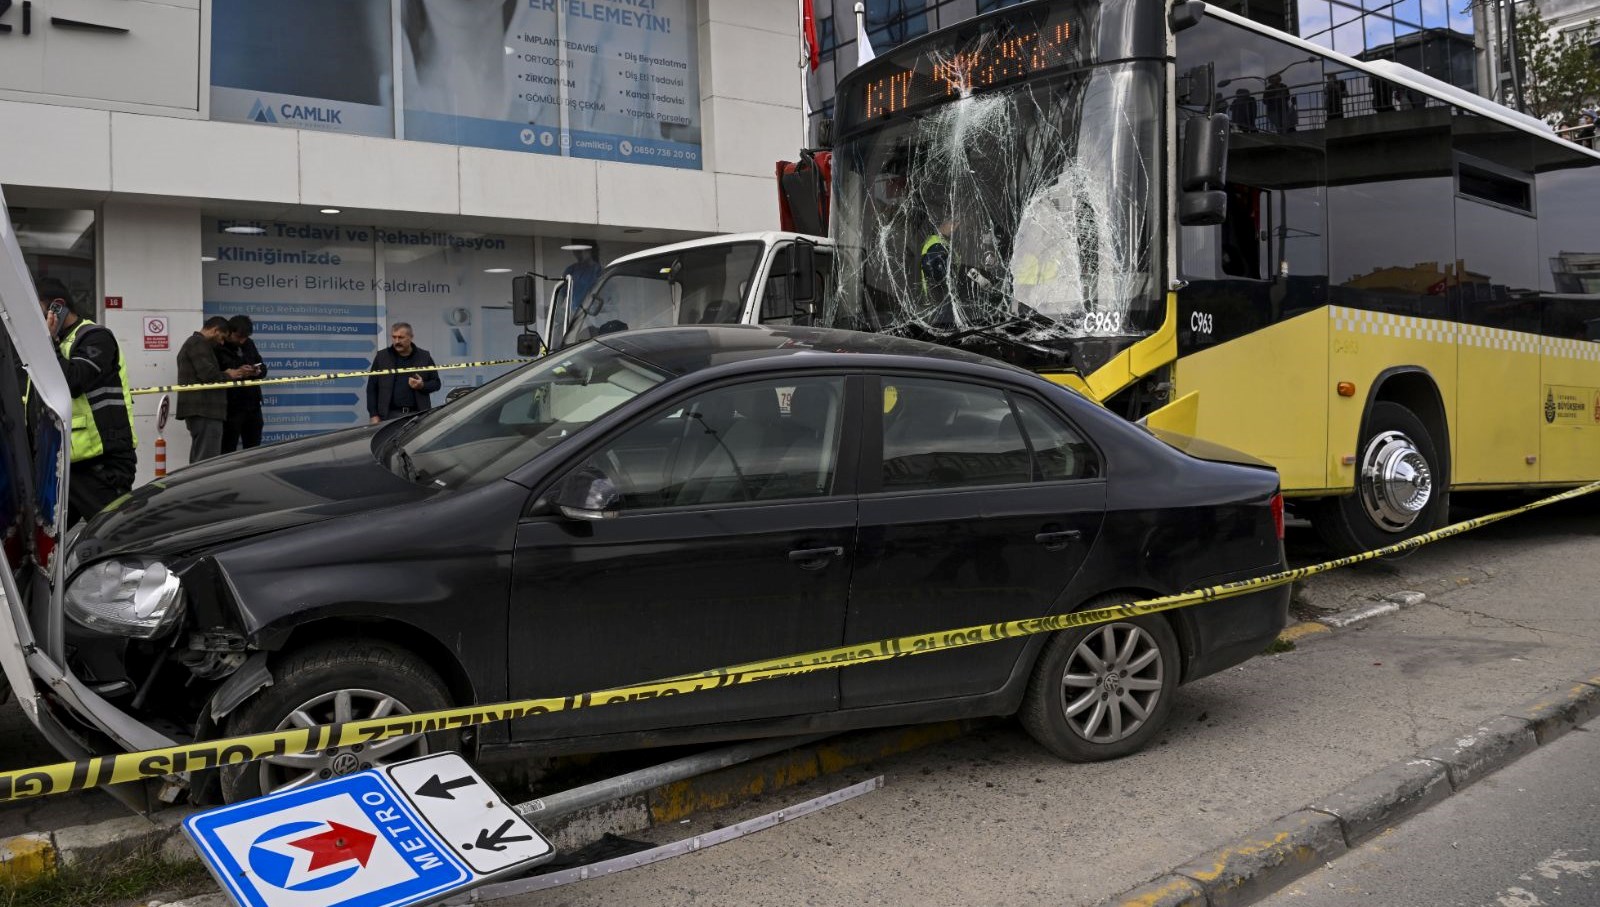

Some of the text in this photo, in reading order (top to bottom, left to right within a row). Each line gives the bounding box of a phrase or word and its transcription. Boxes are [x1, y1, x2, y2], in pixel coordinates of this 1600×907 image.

[639, 54, 687, 70] Beyazlatma
[626, 89, 649, 101] Kanal
[274, 223, 340, 241] Tedavi
[347, 230, 369, 242] ve
[375, 231, 505, 250] Rehabilitasyon
[218, 247, 341, 265] Kliniğimizde
[218, 272, 450, 294] Engelleri Birlikte Kaldıralım
[286, 323, 358, 333] Rehabilitasyonu
[1083, 311, 1121, 332] C963
[1190, 310, 1213, 334] C963
[361, 791, 444, 871] METRO
